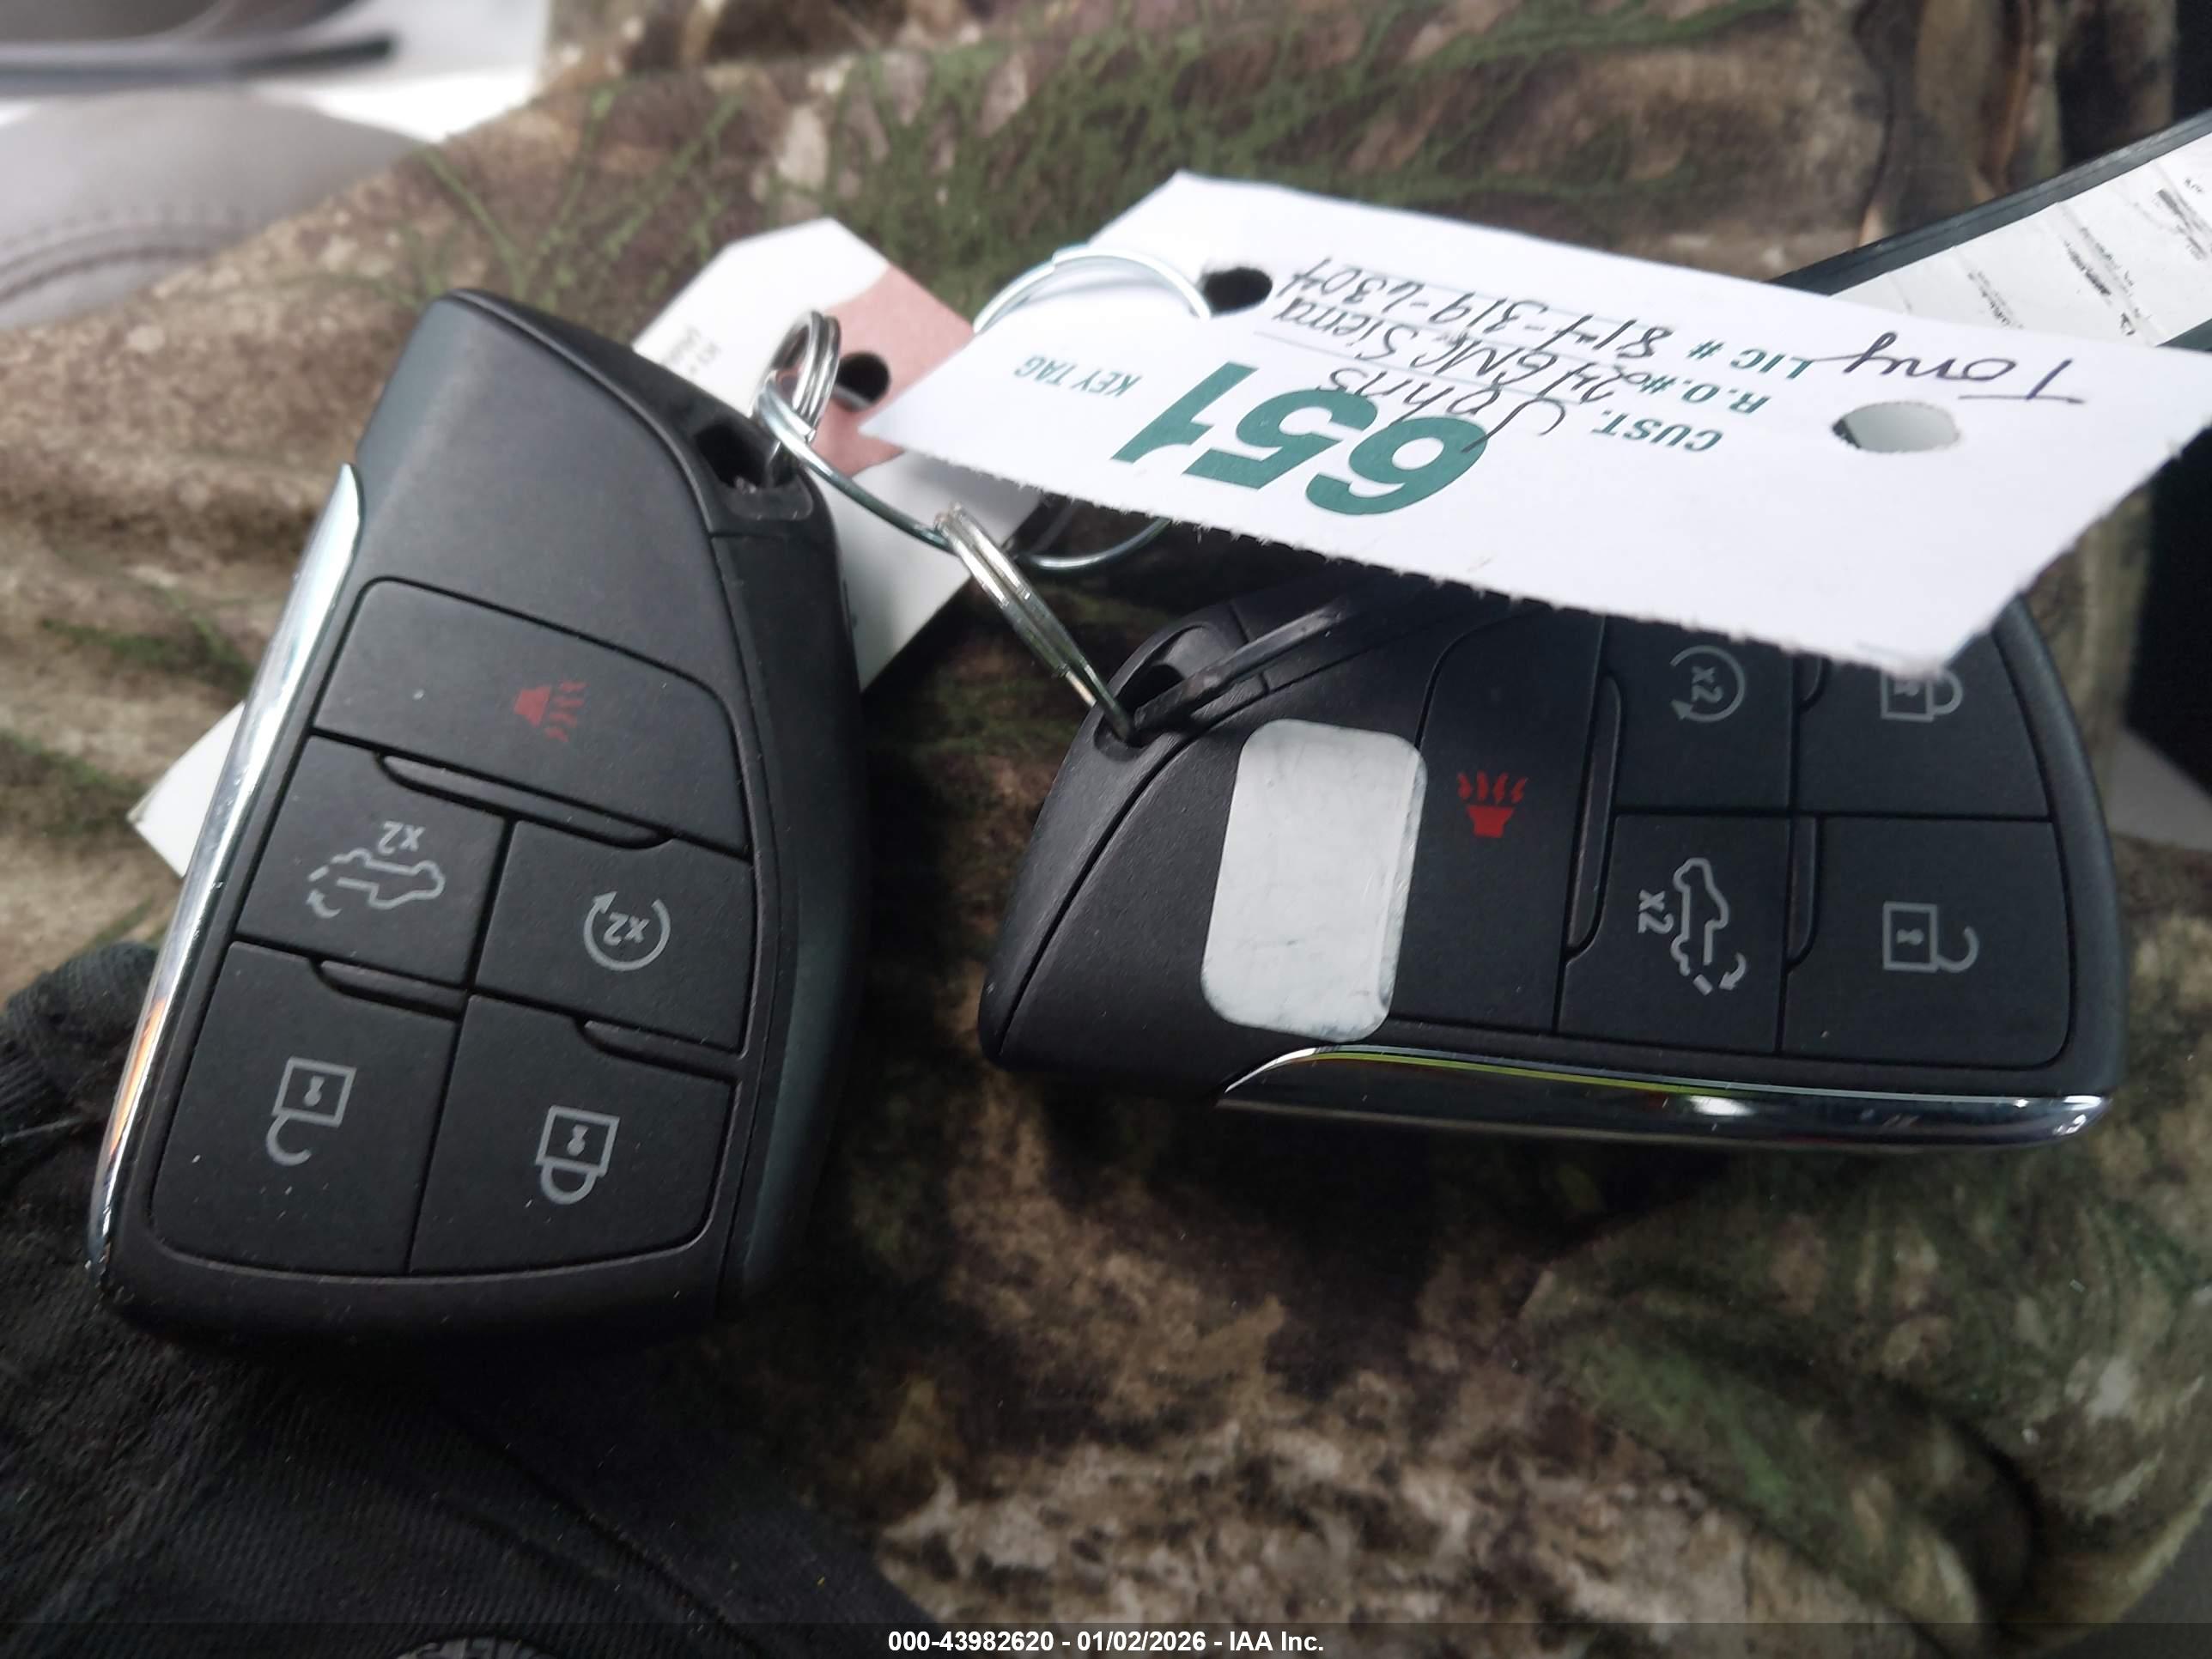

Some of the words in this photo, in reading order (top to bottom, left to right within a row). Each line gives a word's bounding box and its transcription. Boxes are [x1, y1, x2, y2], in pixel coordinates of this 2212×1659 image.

[1273, 297, 1419, 361] Sierra
[1686, 338, 1723, 361] #
[1013, 355, 1078, 389] TAG
[1071, 370, 1143, 398] KEY
[1410, 333, 1558, 388] GMC
[1729, 347, 1814, 381] LIC
[1808, 331, 2086, 404] Tony
[1316, 368, 1565, 453] Johns
[1591, 409, 1724, 453] CUST.
[1110, 362, 1488, 516] 651
